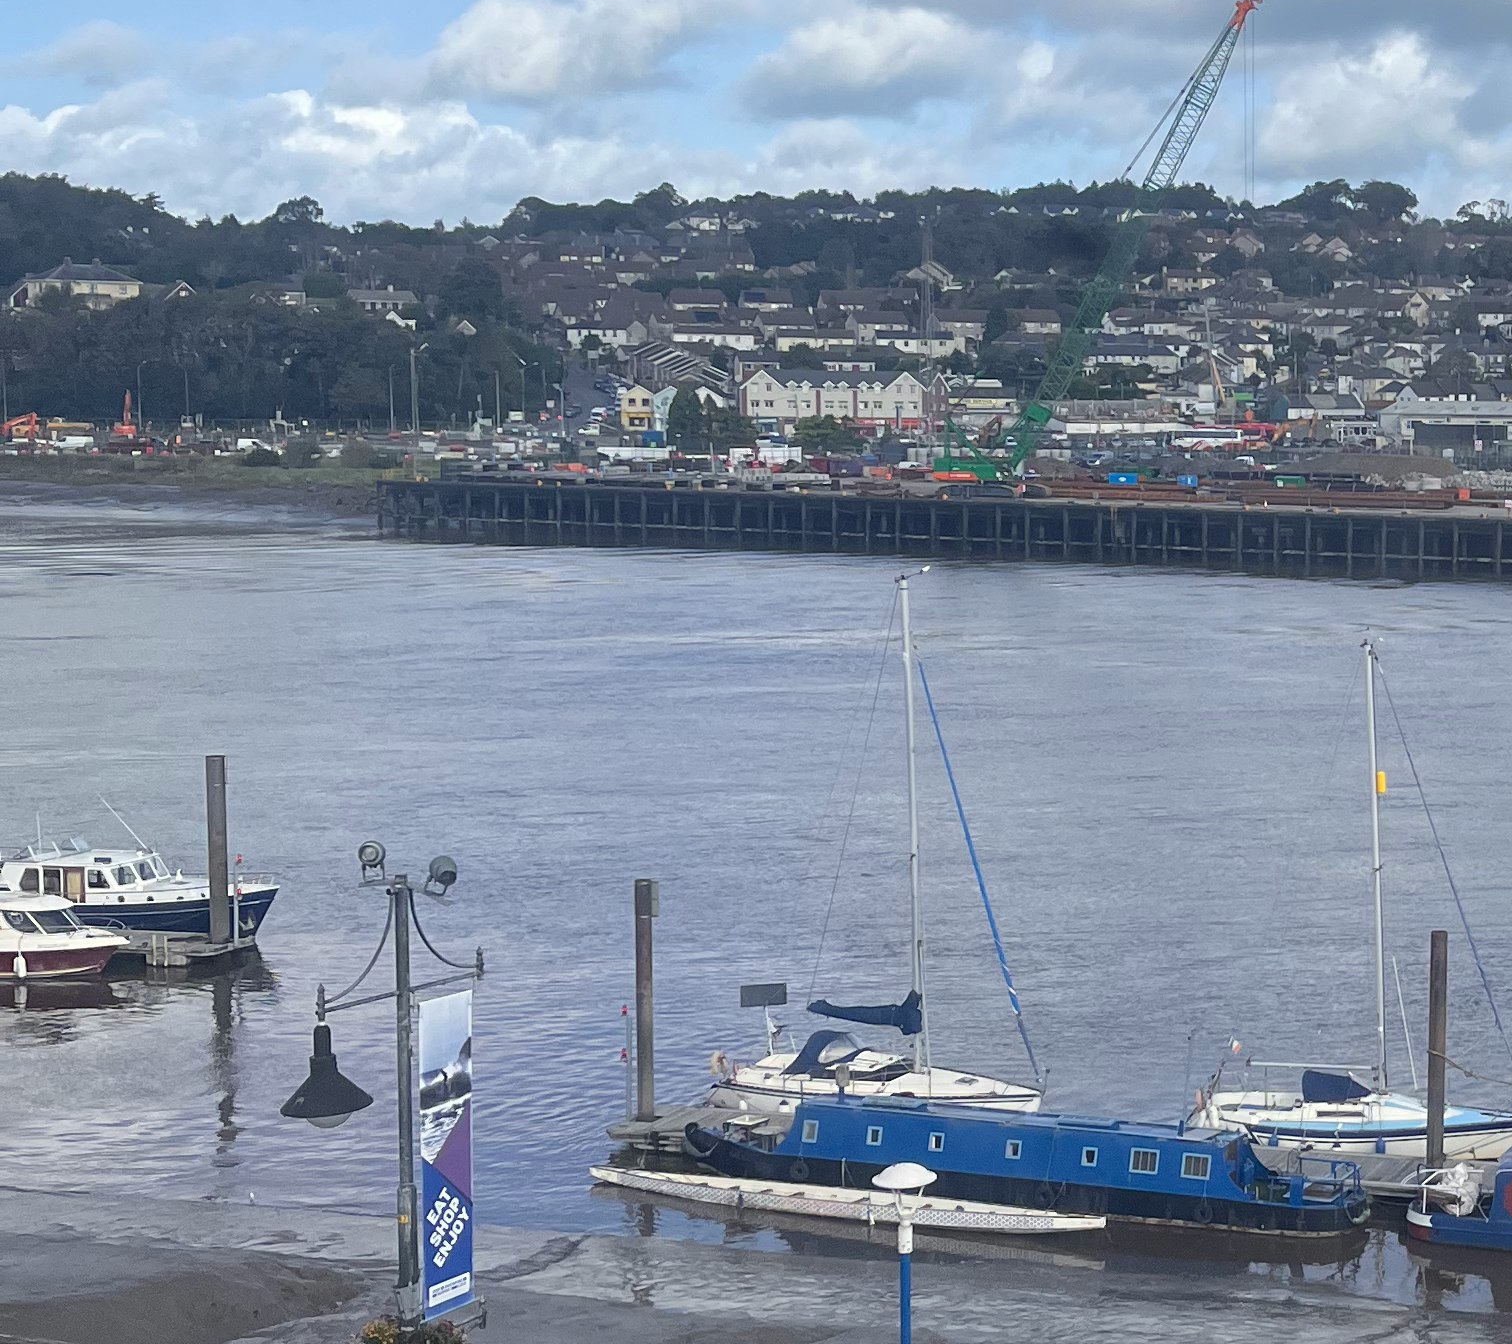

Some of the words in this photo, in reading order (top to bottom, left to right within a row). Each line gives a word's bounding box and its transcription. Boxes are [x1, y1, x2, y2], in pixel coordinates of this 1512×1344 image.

[426, 1186, 451, 1225] EAT
[429, 1197, 459, 1247] SHOP
[433, 1206, 469, 1267] ENJOY
